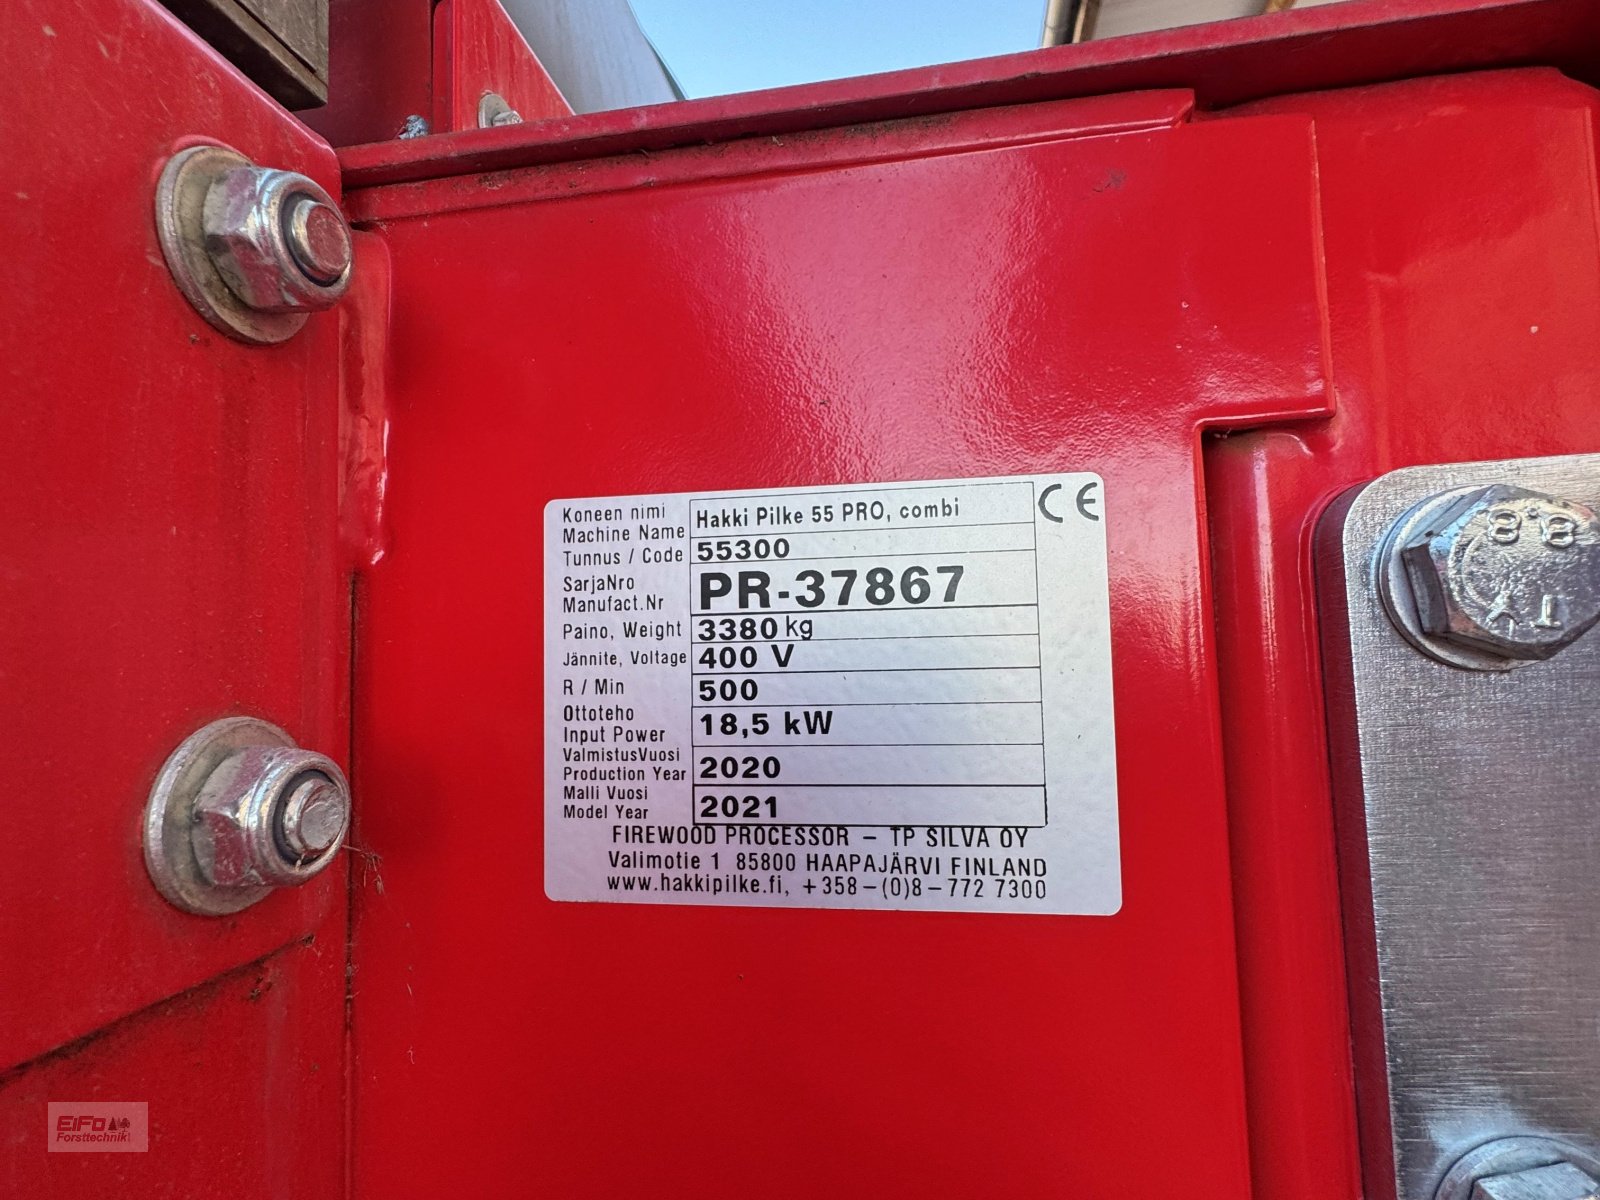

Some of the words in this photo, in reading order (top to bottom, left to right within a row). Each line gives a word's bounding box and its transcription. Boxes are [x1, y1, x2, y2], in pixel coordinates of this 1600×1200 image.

[563, 506, 623, 523] Koneen
[631, 502, 665, 520] nimi
[697, 508, 748, 528] Hakki
[756, 506, 803, 525] Pilke
[811, 505, 834, 523] 55
[842, 500, 891, 522] PRO,
[900, 497, 959, 520] combi
[563, 526, 630, 543] Machine
[639, 525, 685, 540] Name
[563, 550, 621, 566] Tunnus
[629, 548, 634, 564] /
[642, 547, 683, 563] Code
[697, 538, 790, 561] 55300
[563, 574, 634, 593] SarjaNro
[700, 565, 964, 609] PR-37867
[563, 594, 664, 613] Manufact.Nr
[563, 622, 615, 640] Paino,
[623, 620, 682, 641] Weight
[698, 617, 778, 641] 3380
[786, 615, 813, 640] kg
[563, 652, 622, 667] Jännite,
[630, 652, 687, 667] Voltage
[698, 646, 757, 669] 400
[771, 644, 795, 667] V
[563, 680, 573, 695] R
[581, 679, 587, 694] /
[595, 679, 624, 695] Min
[699, 679, 758, 702] 500
[564, 705, 634, 721] Ottoteho
[700, 712, 770, 738] 18,5
[784, 710, 833, 735] kW
[564, 727, 605, 745] Input
[614, 726, 665, 742] Power
[563, 747, 680, 762] ValmistusVuosi
[564, 766, 645, 781] Production
[653, 766, 686, 780] Year
[699, 756, 781, 778] 2020
[564, 786, 600, 800] Malli
[607, 785, 648, 800] Vuosi
[564, 804, 608, 818] Model
[615, 804, 649, 819] Year
[700, 795, 778, 817] 2021
[613, 825, 716, 844] FIREWOOD
[726, 826, 849, 846] PROCESSOR
[890, 827, 915, 846] TP
[926, 827, 990, 847] SILVA
[1000, 828, 1028, 848] OY
[609, 851, 700, 870] Valimotie
[711, 852, 719, 869] 1
[736, 853, 796, 872] 85800
[807, 852, 940, 875] HAAPAJÄRVI
[951, 857, 1046, 877] FINLAND
[607, 873, 789, 896] www.hakkipilke.fi,
[995, 879, 1046, 899] 7300
